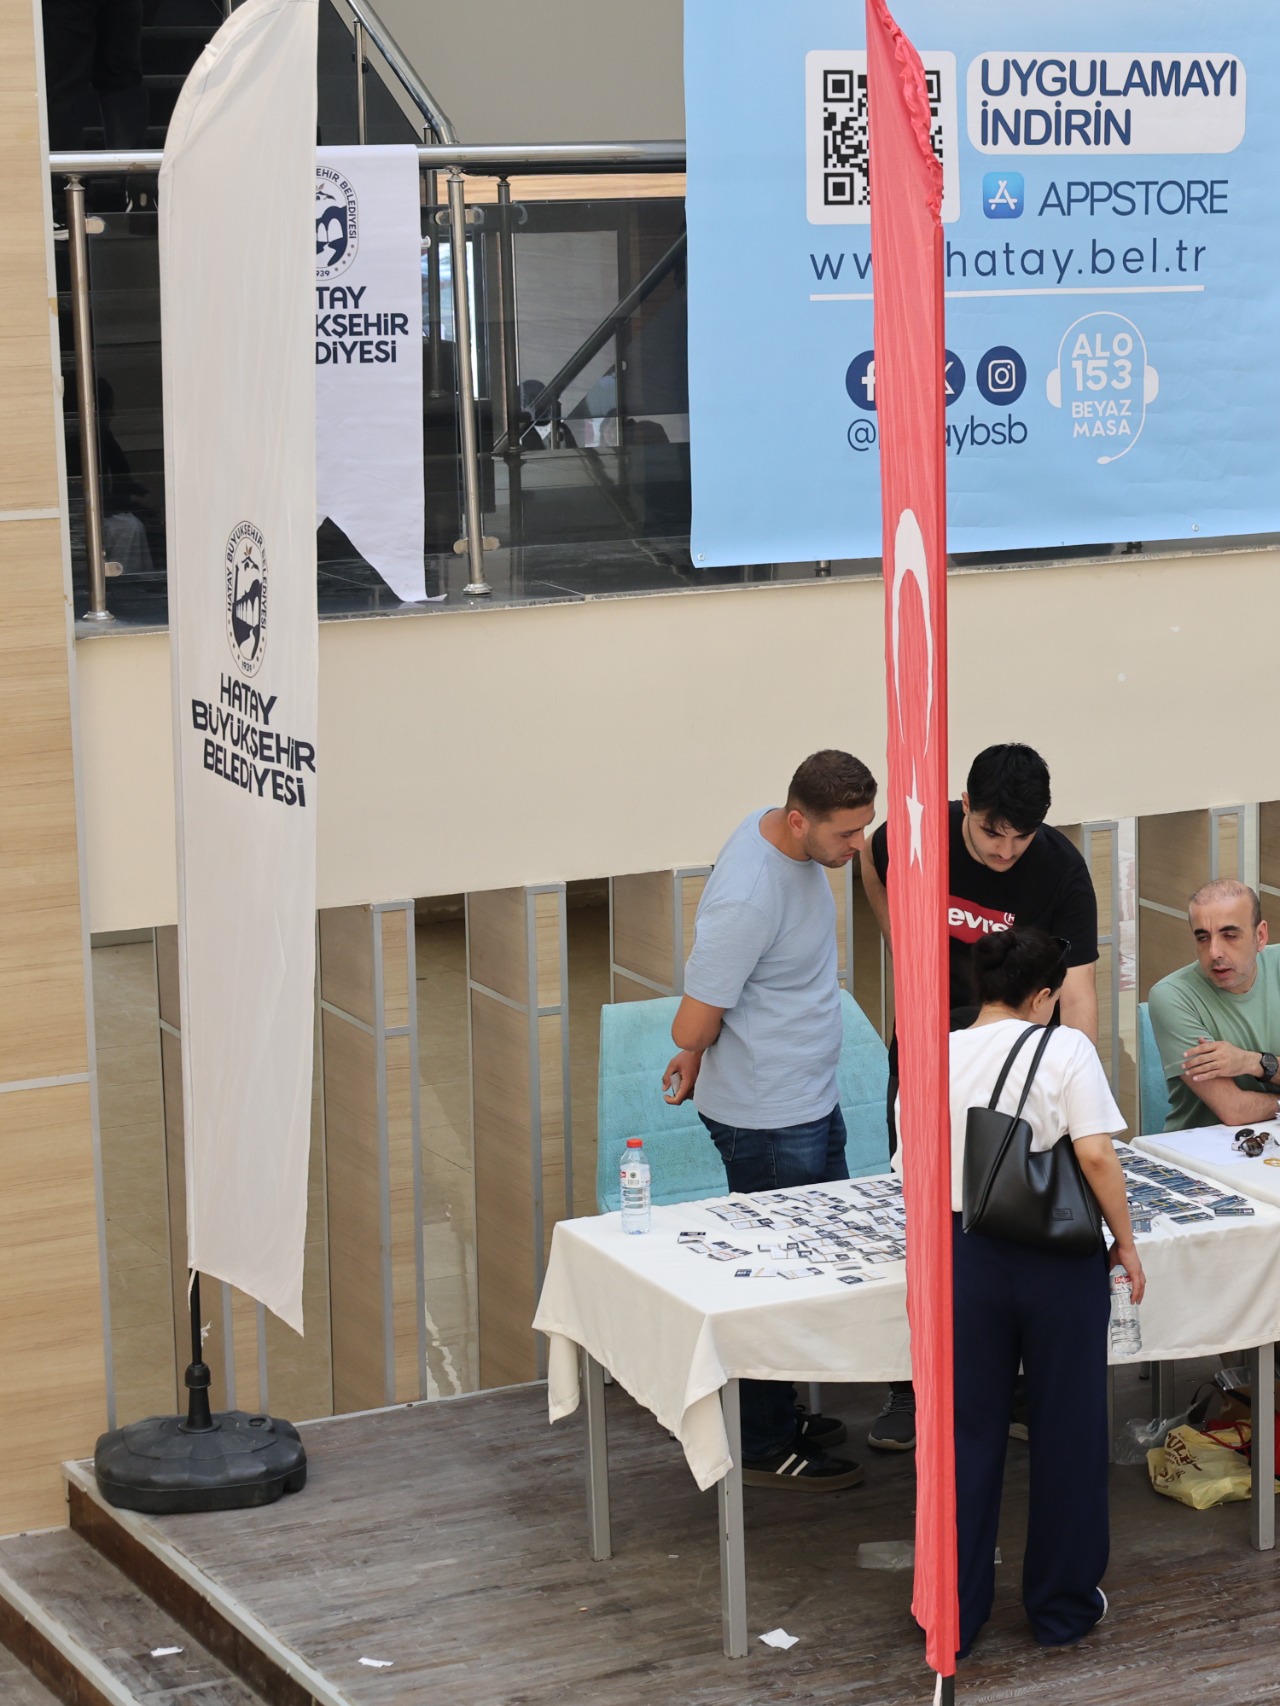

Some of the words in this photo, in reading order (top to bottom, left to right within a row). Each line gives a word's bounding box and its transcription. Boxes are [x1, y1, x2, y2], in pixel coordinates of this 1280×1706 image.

[981, 59, 1237, 97] UYGULAMAYI
[981, 100, 1132, 146] İNDİRİN
[1037, 179, 1229, 217] APPSTORE
[810, 237, 1206, 284] wwhatay.bel.tr
[316, 286, 367, 310] TAY
[316, 313, 408, 338] KŞEHİR
[316, 340, 396, 364] DİYESİ
[1072, 332, 1133, 358] ALO
[1072, 358, 1132, 392] 153
[1072, 400, 1132, 418] BEYAZ
[1073, 418, 1132, 438] MASA
[220, 672, 278, 726] HATAY
